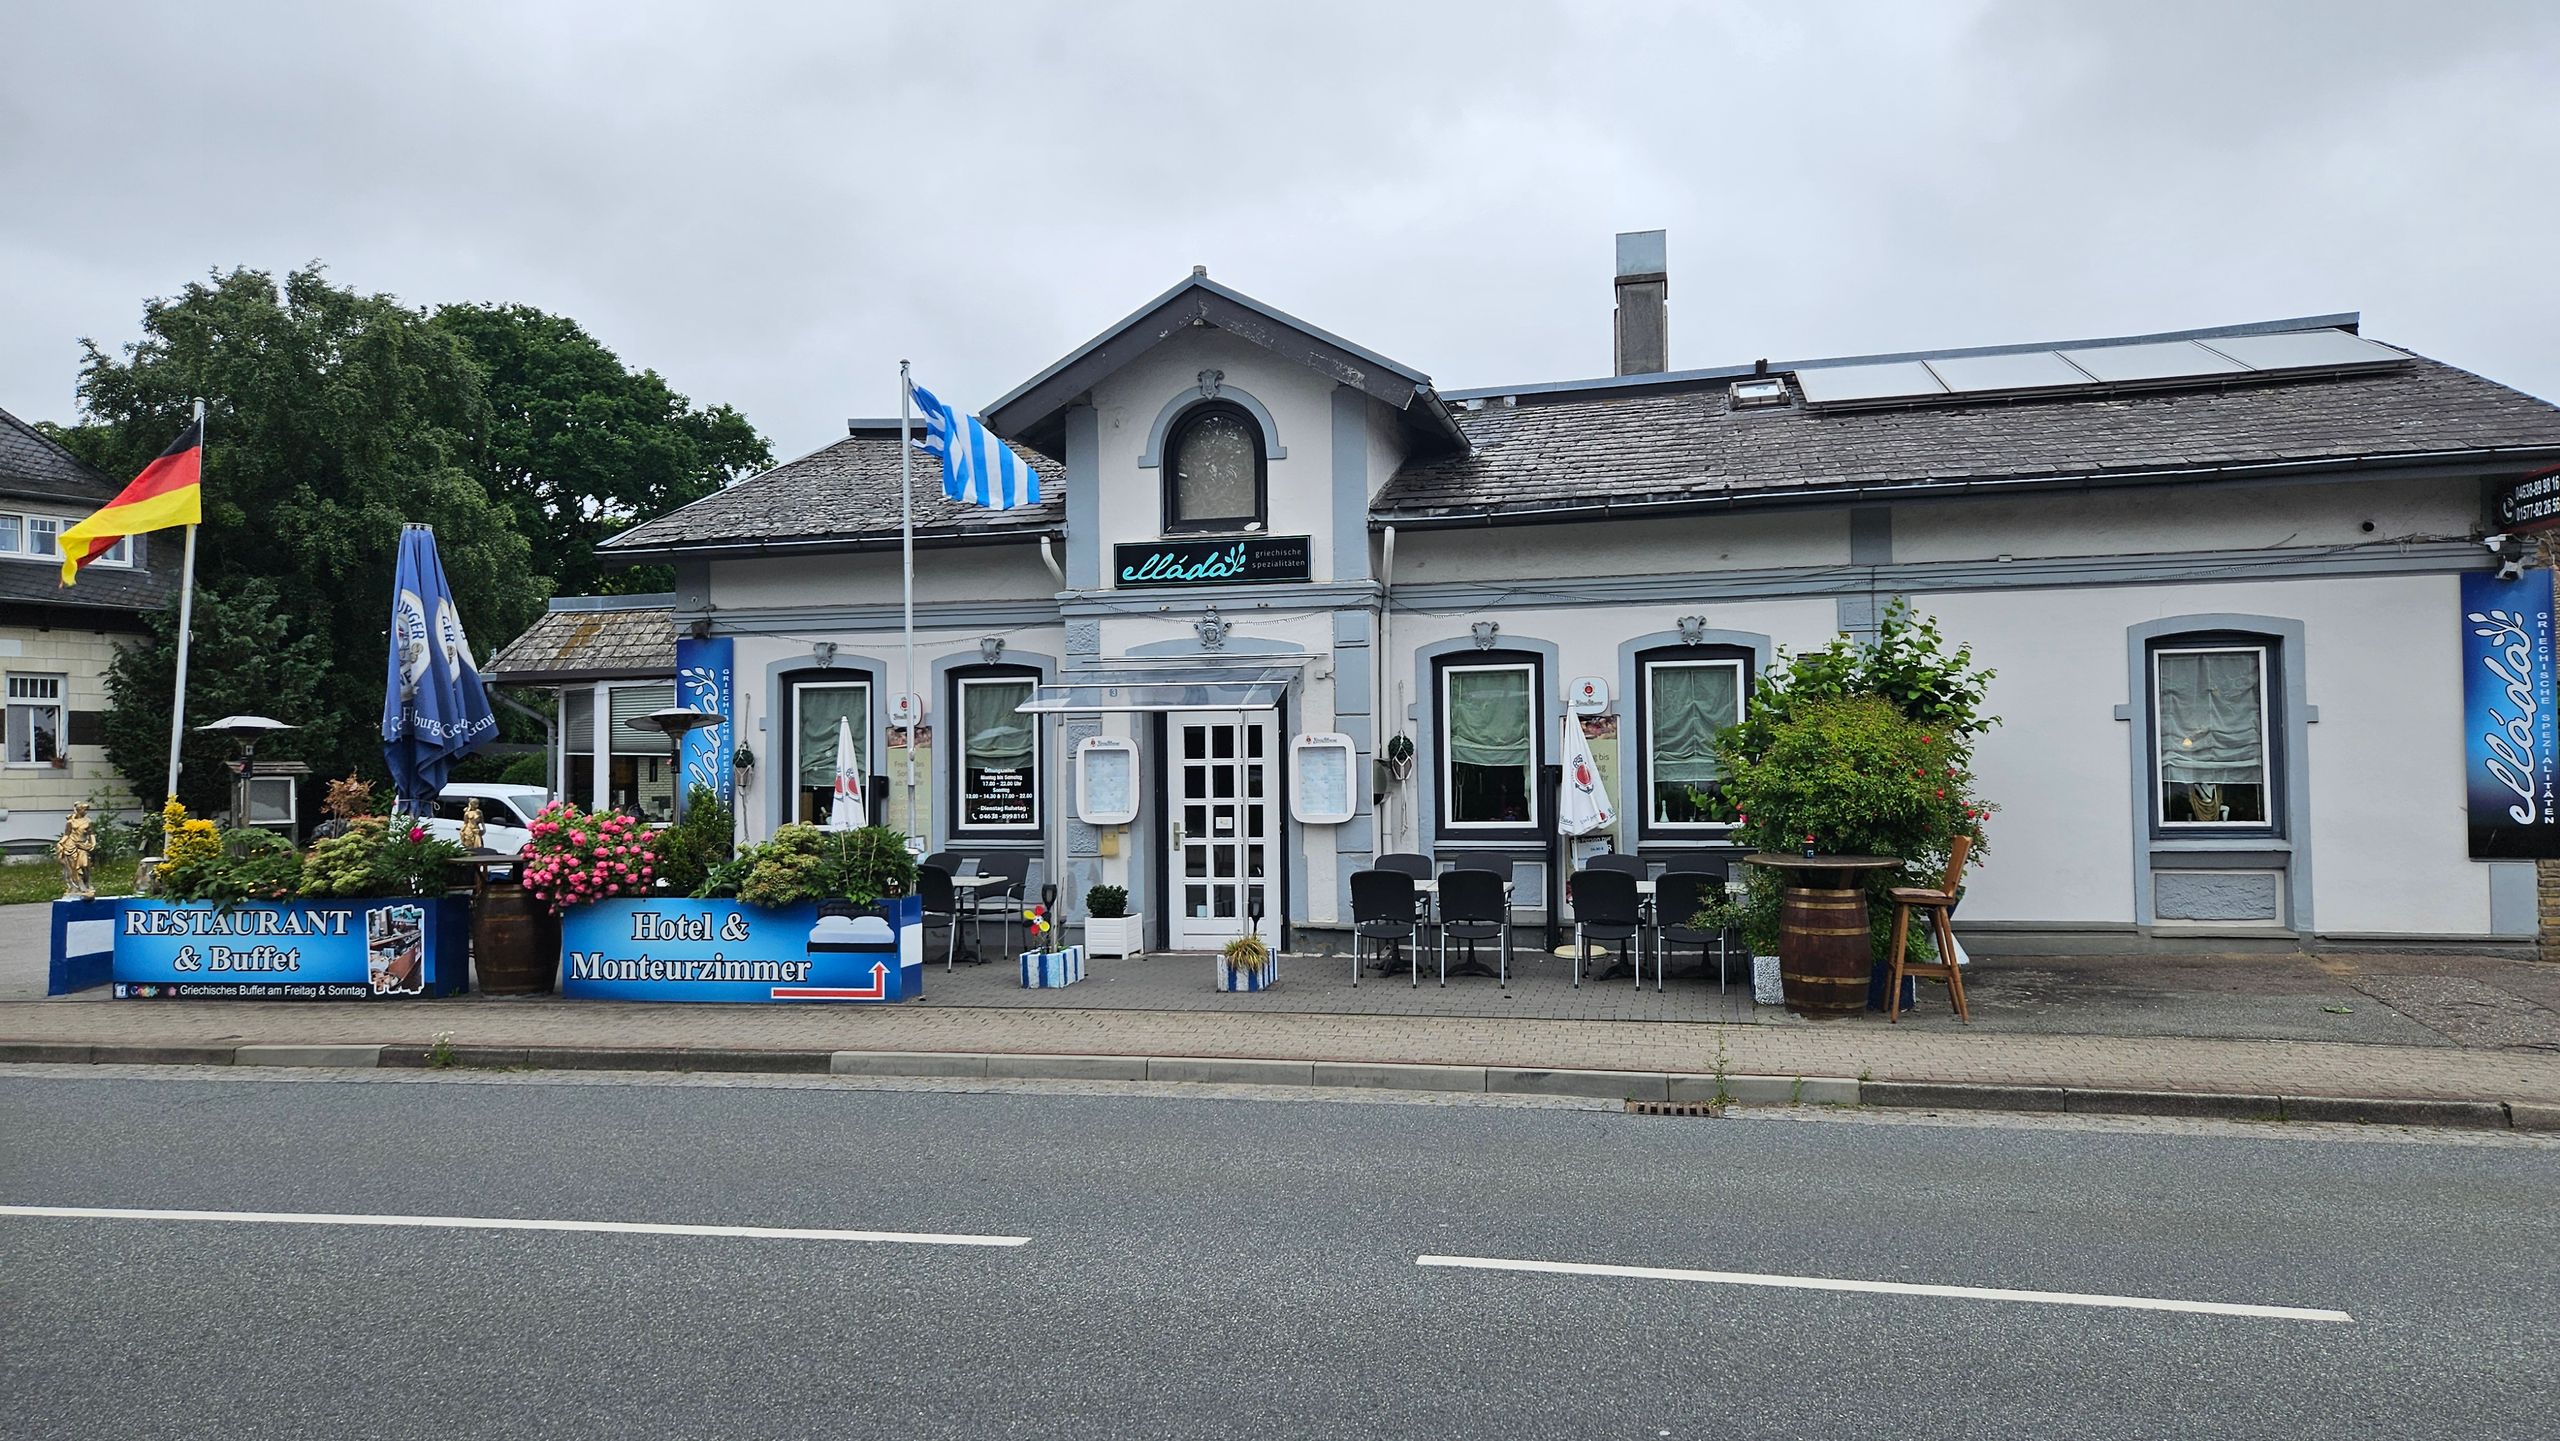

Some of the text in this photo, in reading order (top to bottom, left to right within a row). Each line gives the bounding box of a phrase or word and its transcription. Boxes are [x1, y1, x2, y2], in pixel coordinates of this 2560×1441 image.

[1251, 558, 1306, 569] spezialitäten
[1255, 548, 1302, 559] griechische
[2536, 612, 2555, 825] GRIECHISCHE SPEZIALITÄTEN
[124, 910, 352, 936] RESTAURANT
[631, 912, 750, 941] Hotel &
[173, 946, 300, 972] & Buffet
[570, 952, 812, 982] Monteurzimmer
[180, 984, 238, 996] Griechisches
[239, 984, 266, 996] Buffet
[267, 987, 283, 996] am
[284, 984, 317, 998] Freitag
[318, 985, 326, 996] &
[328, 985, 367, 998] Sonntag
